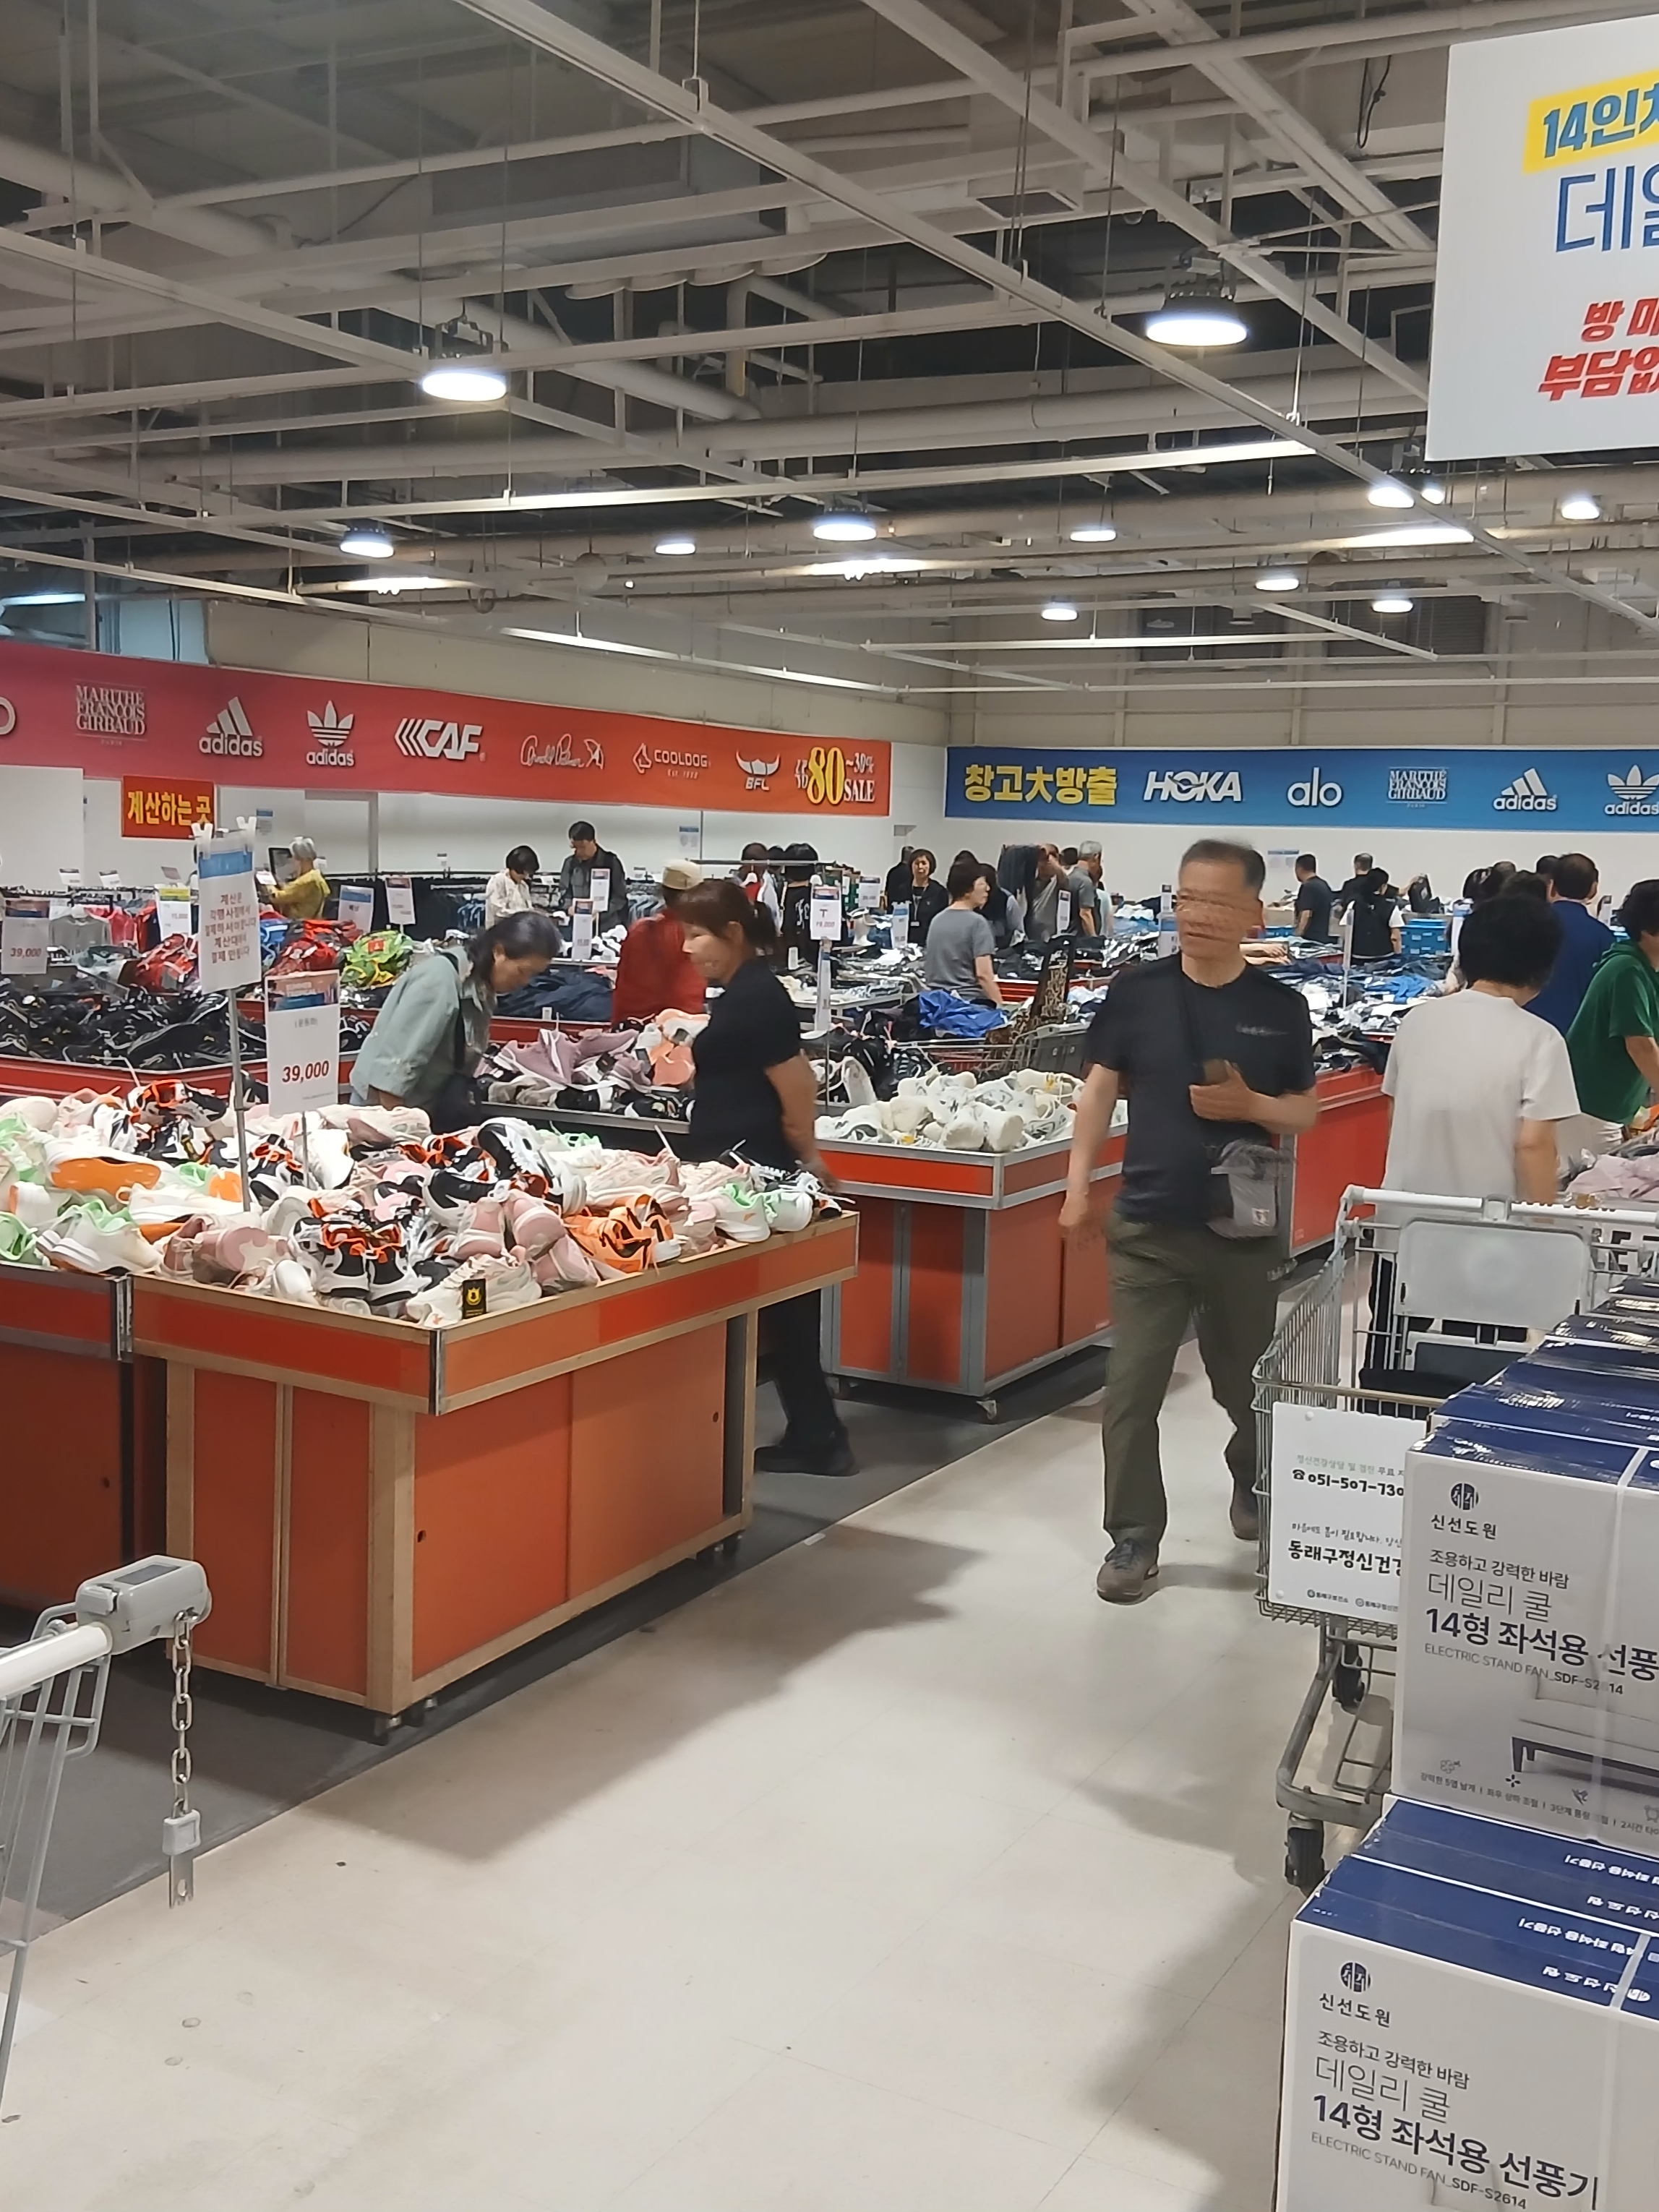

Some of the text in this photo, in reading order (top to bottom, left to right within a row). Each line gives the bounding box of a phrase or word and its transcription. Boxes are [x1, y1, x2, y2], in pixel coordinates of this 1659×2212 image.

[1581, 300, 1625, 343] 방
[76, 713, 145, 735] GIRBAUD
[199, 733, 263, 757] adidas
[306, 748, 355, 766] adidas
[654, 749, 708, 768] COOLDOG
[745, 776, 770, 792] BFL
[807, 746, 845, 805] 80
[844, 778, 875, 802] SALE
[1144, 771, 1242, 802] HOKA
[1287, 767, 1342, 807] alo
[128, 791, 211, 826] 계산하는 곳
[1388, 789, 1446, 800] GIRBAUD
[1493, 794, 1556, 810] adidas
[1605, 801, 1659, 815] adidas
[10, 947, 42, 959] 39,000
[282, 1060, 330, 1084] 39,000
[1378, 1466, 1395, 1477] 무료
[1429, 1548, 1570, 1590] 조용하고 강력한 바람
[1428, 1572, 1553, 1624] 데일리 쿨
[1426, 1608, 1491, 1646] 14형
[1497, 1621, 1589, 1666] 좌석용
[1424, 1642, 1624, 1695] ELECTRIC STAND FAN_SDF-S214
[1317, 2030, 1470, 2090] 조용하고 강력한 바람
[1316, 2056, 1451, 2124] 데일리 쿨
[1313, 2094, 1598, 2211] 14형 좌석용 선풍기
[1311, 2131, 1527, 2211] ELECTRIC STAND FAN_SDF-S2614
